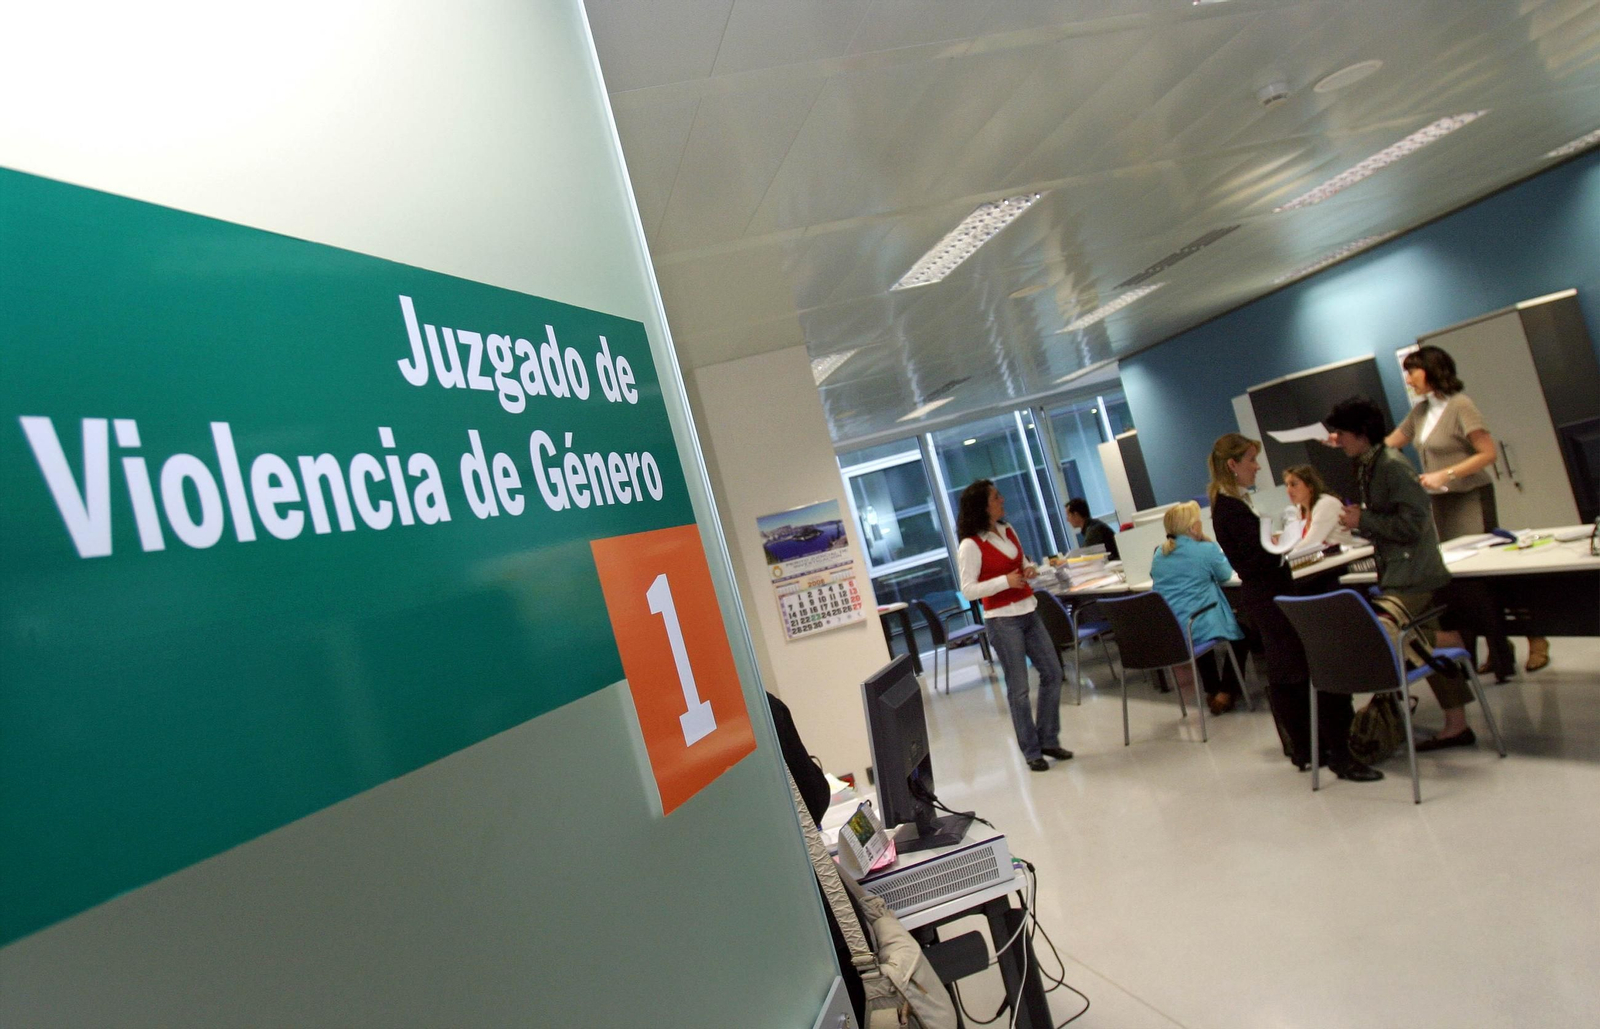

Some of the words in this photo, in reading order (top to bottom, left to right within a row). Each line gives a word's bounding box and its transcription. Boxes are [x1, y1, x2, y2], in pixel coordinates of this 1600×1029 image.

[398, 295, 590, 413] Juzgado
[596, 336, 638, 404] de
[20, 417, 451, 557] Violencia
[461, 430, 524, 519] de
[530, 430, 662, 511] Género
[791, 619, 798, 627] 21
[801, 616, 811, 624] 22
[821, 611, 832, 619] 24
[832, 608, 842, 616] 25
[843, 605, 852, 613] 26
[853, 602, 862, 610] 27
[792, 627, 802, 635] 28
[803, 624, 813, 632] 29
[813, 621, 823, 629] 30
[810, 606, 818, 614] 16
[646, 573, 717, 748] 1
